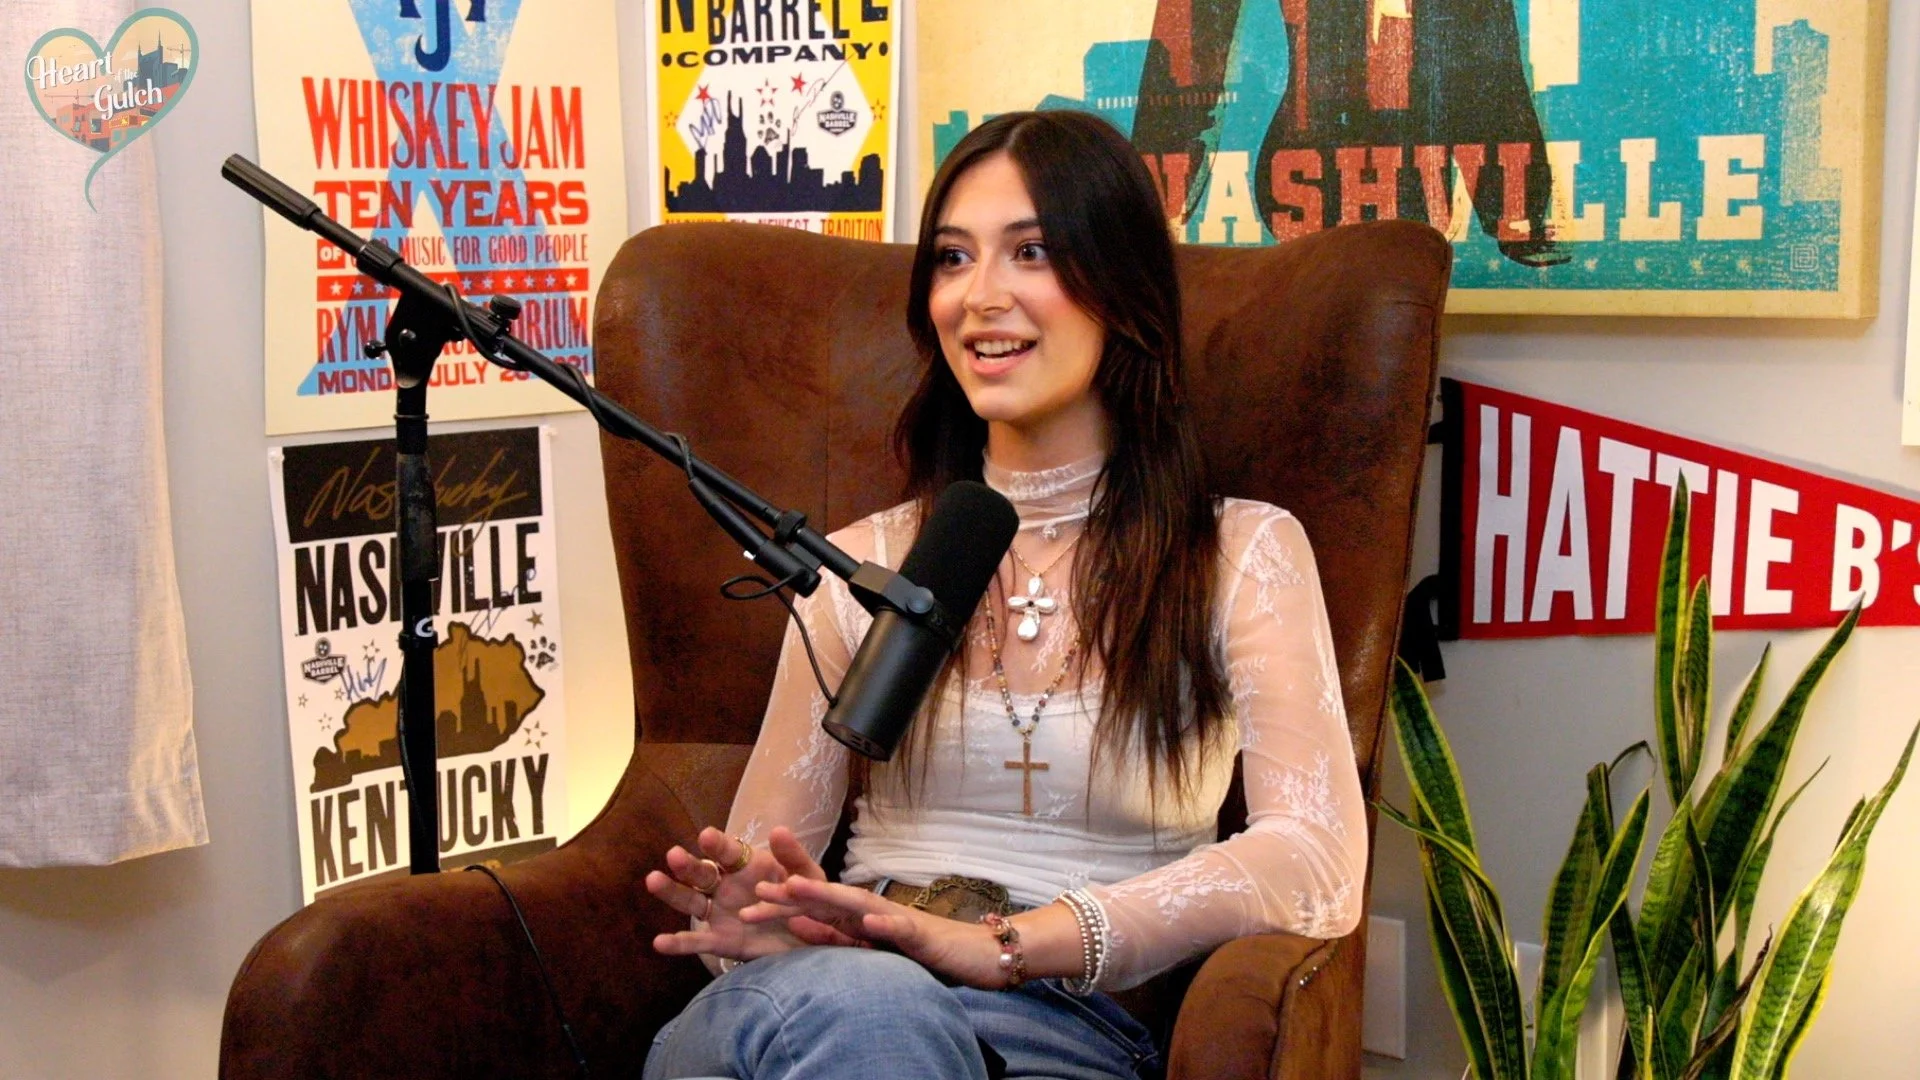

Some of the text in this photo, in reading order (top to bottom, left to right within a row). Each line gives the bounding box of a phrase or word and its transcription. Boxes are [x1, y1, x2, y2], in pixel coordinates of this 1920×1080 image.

[708, 0, 850, 45] BARREL
[676, 42, 873, 68] COMPANY
[301, 76, 497, 170] WHISKEY
[499, 84, 585, 170] JAM
[313, 180, 589, 229] TEN YEARS
[319, 246, 342, 262] OF
[454, 235, 482, 264] FOR
[488, 235, 528, 264] GOOD
[534, 233, 589, 262] PEOPLE
[316, 305, 391, 364] RYM
[317, 366, 398, 396] MOND
[428, 361, 489, 387] JULY
[310, 753, 549, 887] KENUCKY
